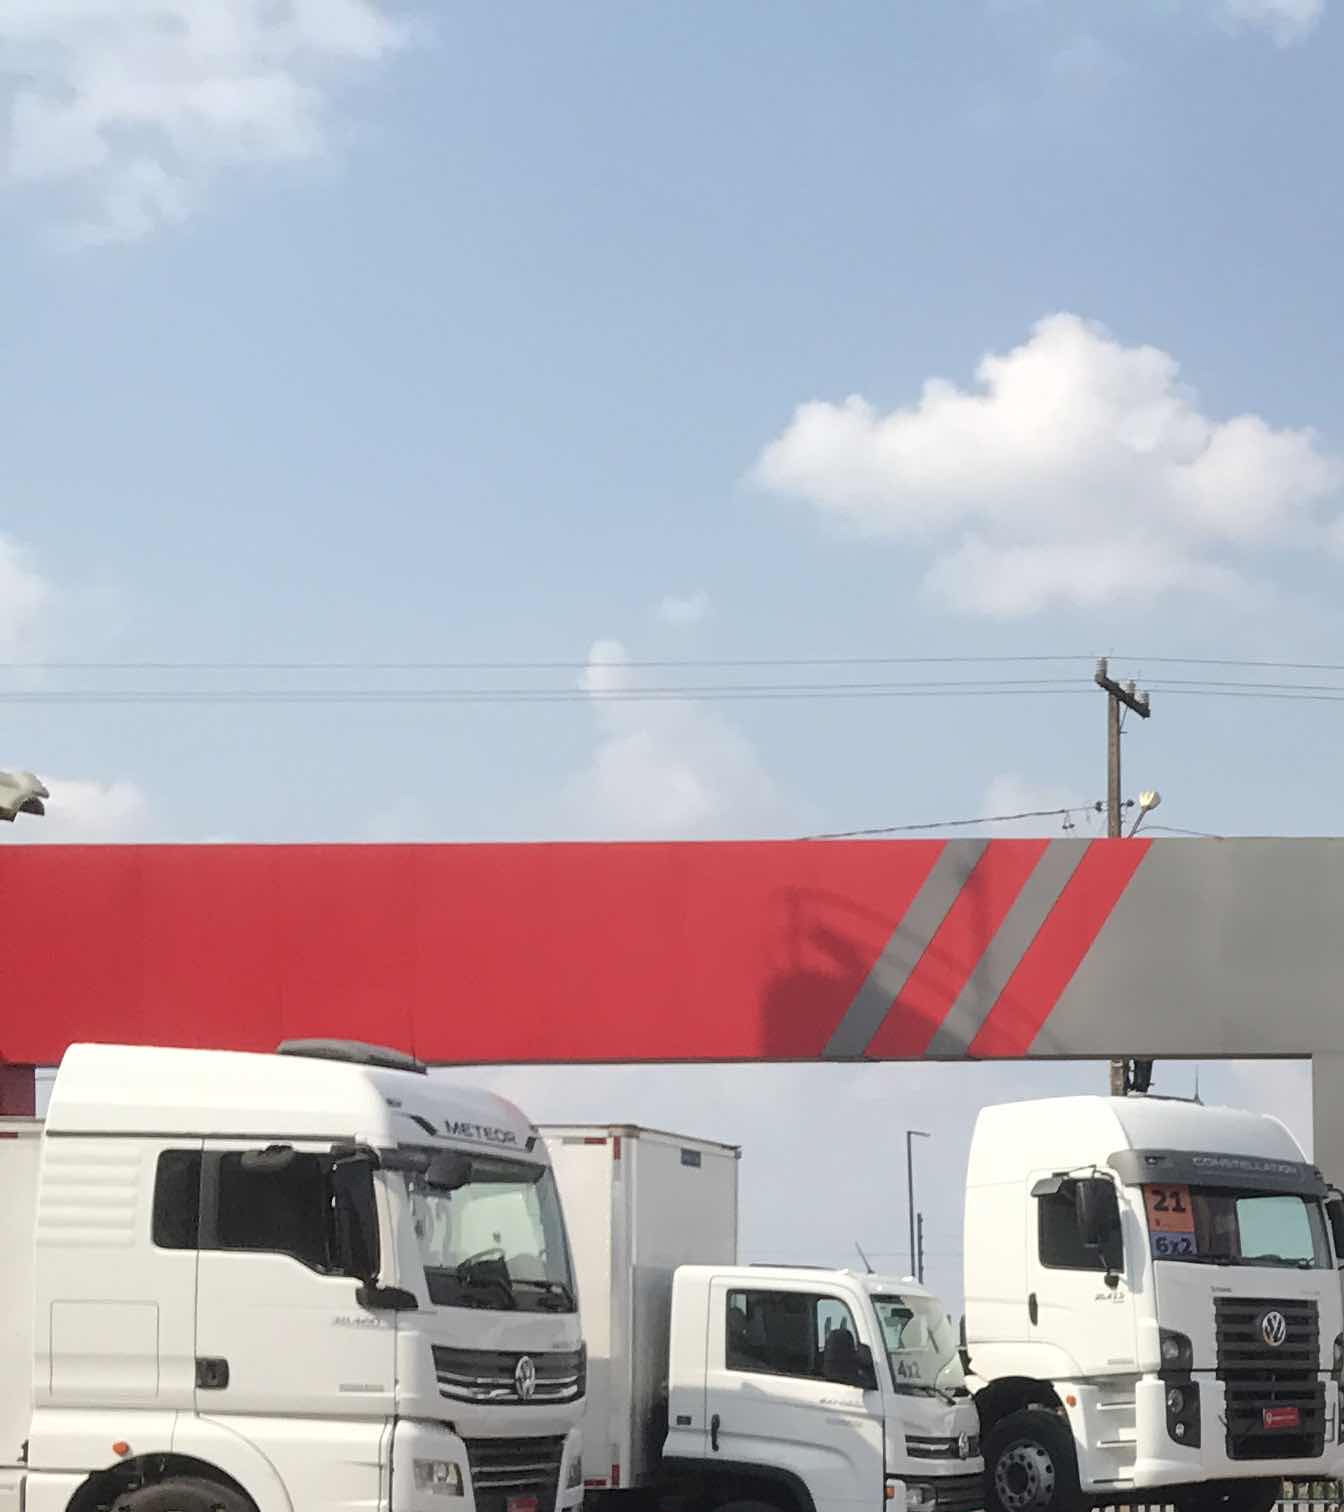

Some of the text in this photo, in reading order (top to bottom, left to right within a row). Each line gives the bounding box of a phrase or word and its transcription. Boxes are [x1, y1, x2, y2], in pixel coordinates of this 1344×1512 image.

[445, 1120, 517, 1144] METEOR
[1151, 1190, 1186, 1212] 21
[1155, 1236, 1192, 1256] 6x2
